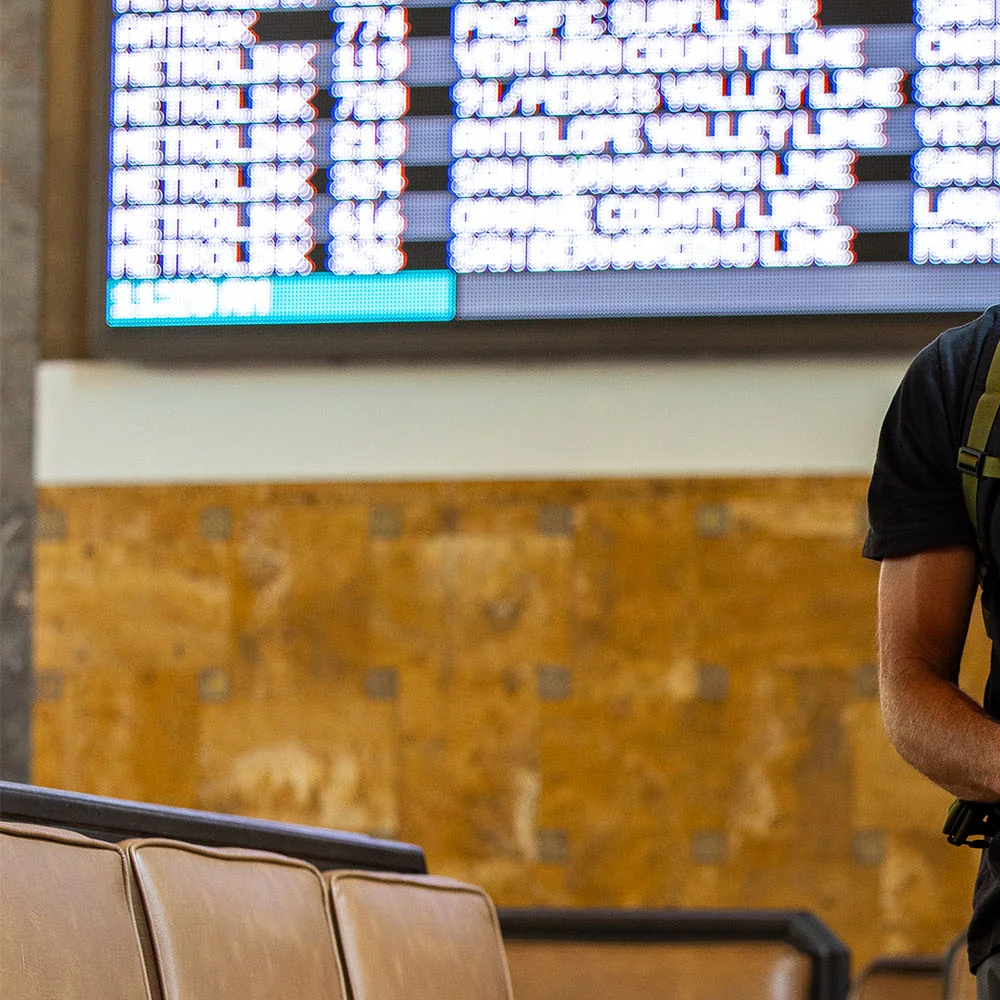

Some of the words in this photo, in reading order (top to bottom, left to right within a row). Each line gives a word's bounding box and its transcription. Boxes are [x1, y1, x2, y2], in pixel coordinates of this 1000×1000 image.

[112, 8, 259, 50] AMTRAK
[112, 43, 318, 86] METROLINK
[452, 35, 623, 78] VENTURA
[623, 31, 770, 73] COUNTY
[770, 29, 867, 70] LINE
[111, 82, 318, 126] METROLINK
[661, 71, 807, 112] VALLEY
[807, 68, 907, 109] LINE
[110, 122, 317, 165] METROLINK
[449, 115, 644, 157] ANTELOPE
[644, 111, 792, 153] VALLEY
[792, 109, 889, 149] LINE
[109, 161, 317, 204] METROLINK
[760, 150, 858, 190] LINE
[108, 200, 316, 242] METROLINK
[597, 192, 744, 233] COUNTY
[744, 190, 841, 230] LINE
[107, 236, 315, 277] METROLINK
[760, 226, 857, 266] LINE
